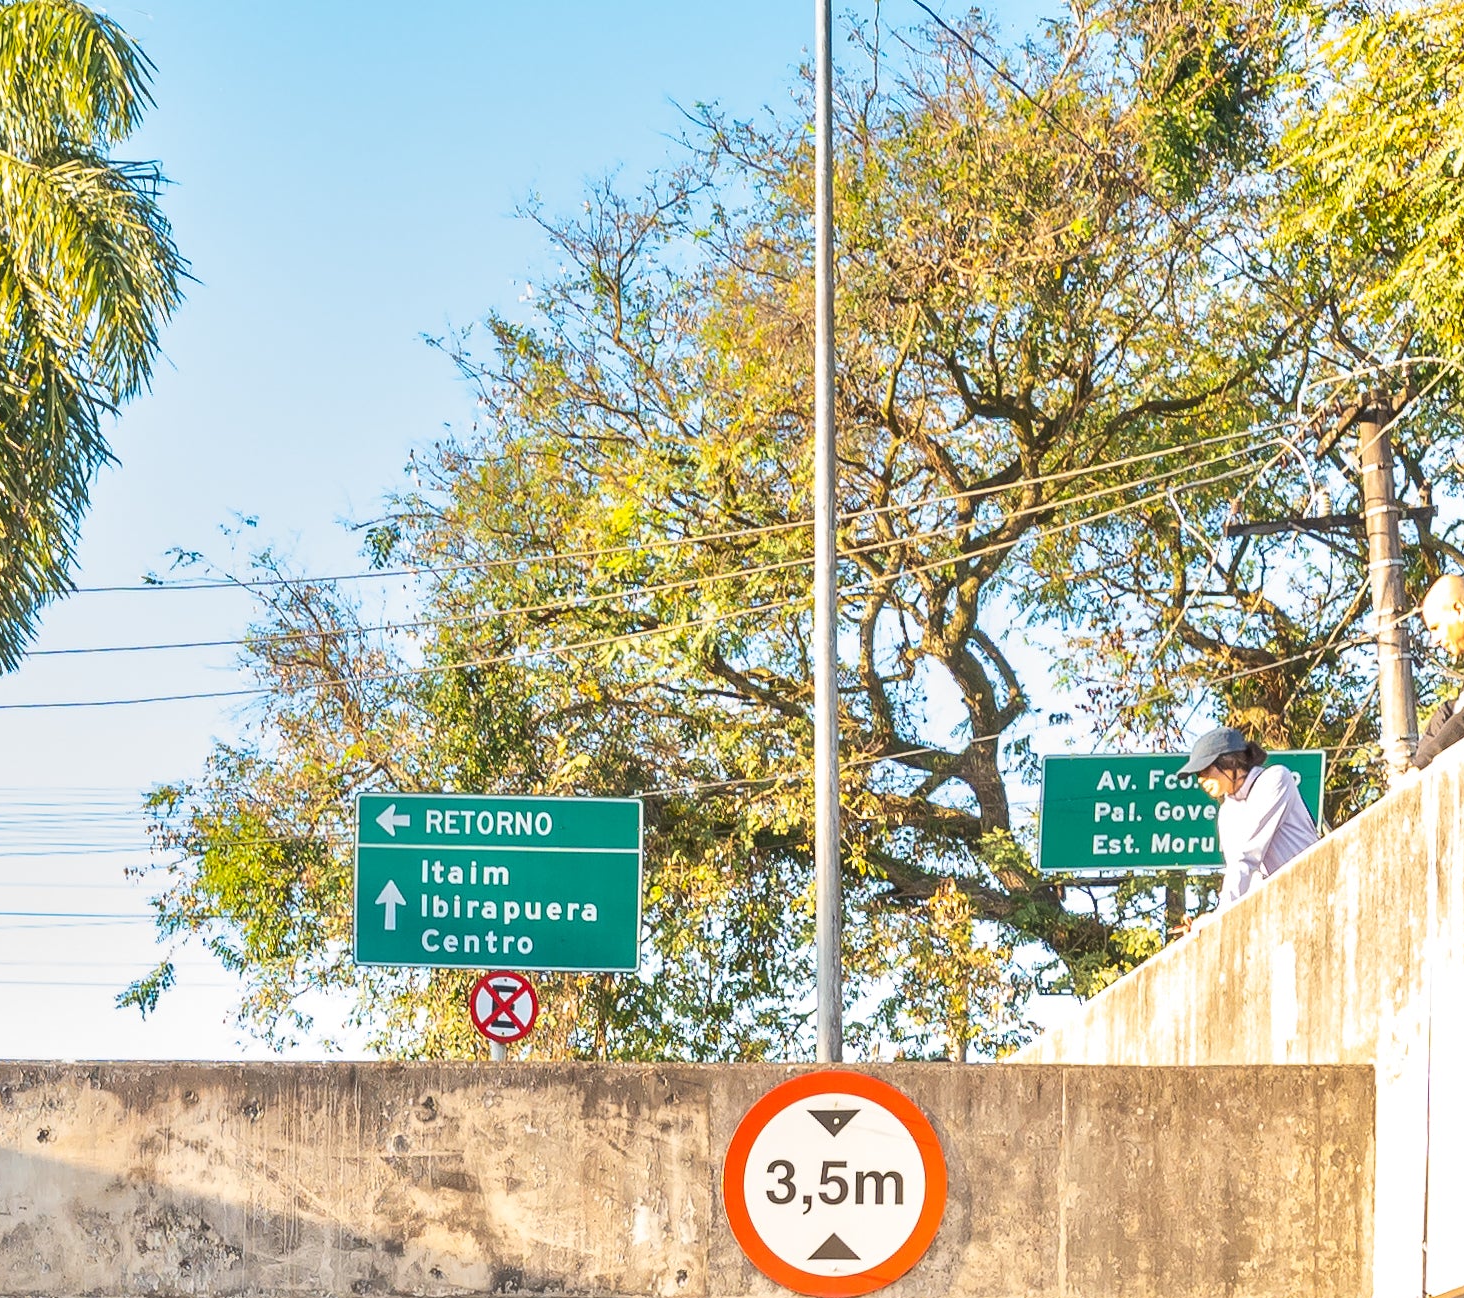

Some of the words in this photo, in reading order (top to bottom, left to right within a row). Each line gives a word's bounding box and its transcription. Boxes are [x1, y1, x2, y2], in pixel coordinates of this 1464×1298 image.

[1097, 771, 1137, 791] Av.
[426, 810, 552, 835] RETORNO
[1094, 802, 1142, 822] Pal.
[1093, 834, 1139, 854] Est.
[421, 860, 509, 885] Itaim
[421, 894, 598, 925] Ibirapuera
[421, 929, 534, 954] Centro
[766, 1160, 903, 1215] 3,5m
